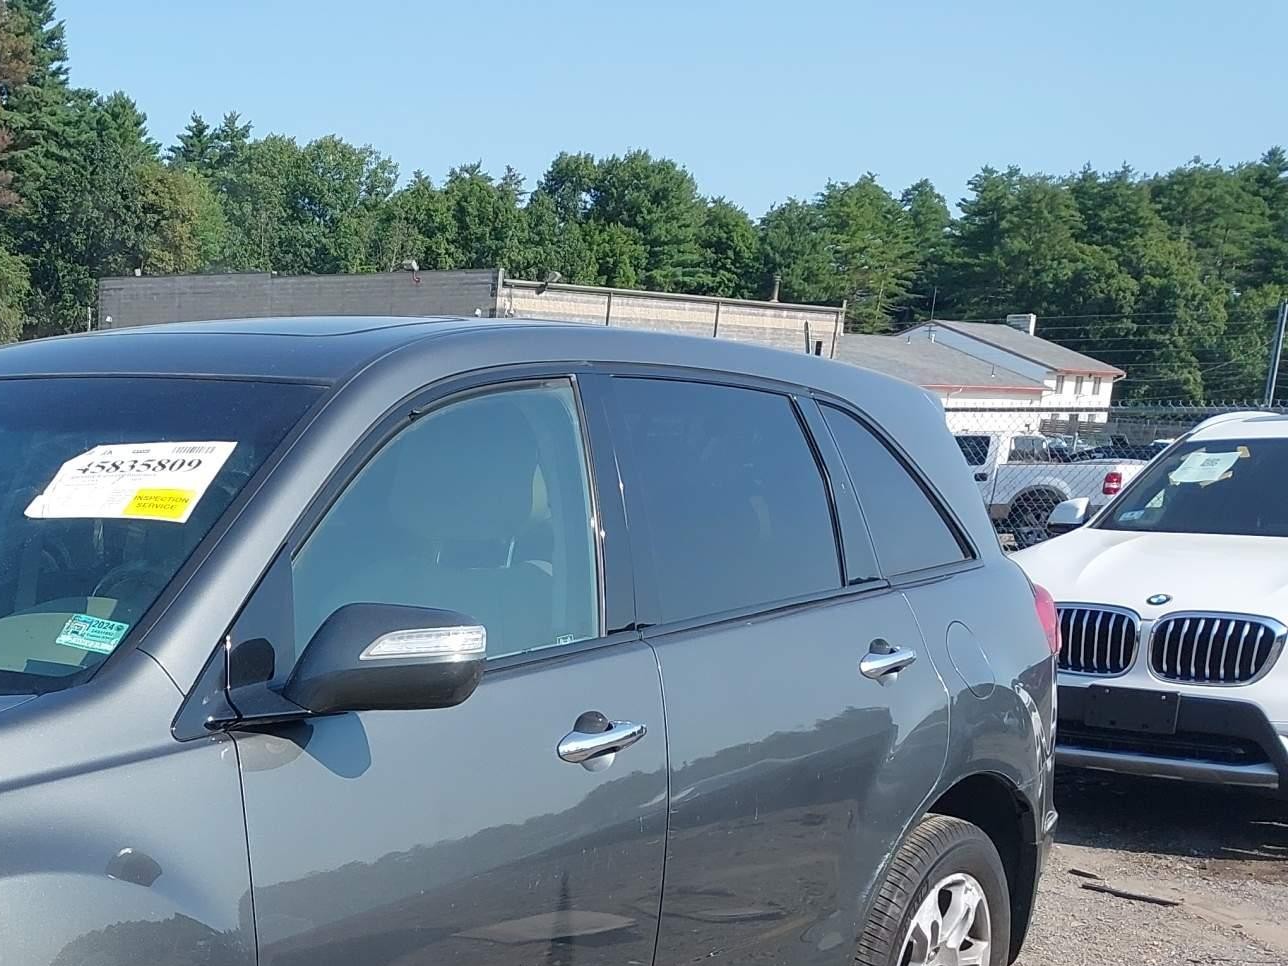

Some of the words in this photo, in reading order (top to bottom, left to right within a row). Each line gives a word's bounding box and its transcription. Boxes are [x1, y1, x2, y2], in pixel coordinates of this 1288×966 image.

[76, 458, 203, 474] 45835809
[133, 495, 190, 504] INSPECTION
[135, 502, 177, 510] SERVICE
[92, 619, 115, 631] 2024
